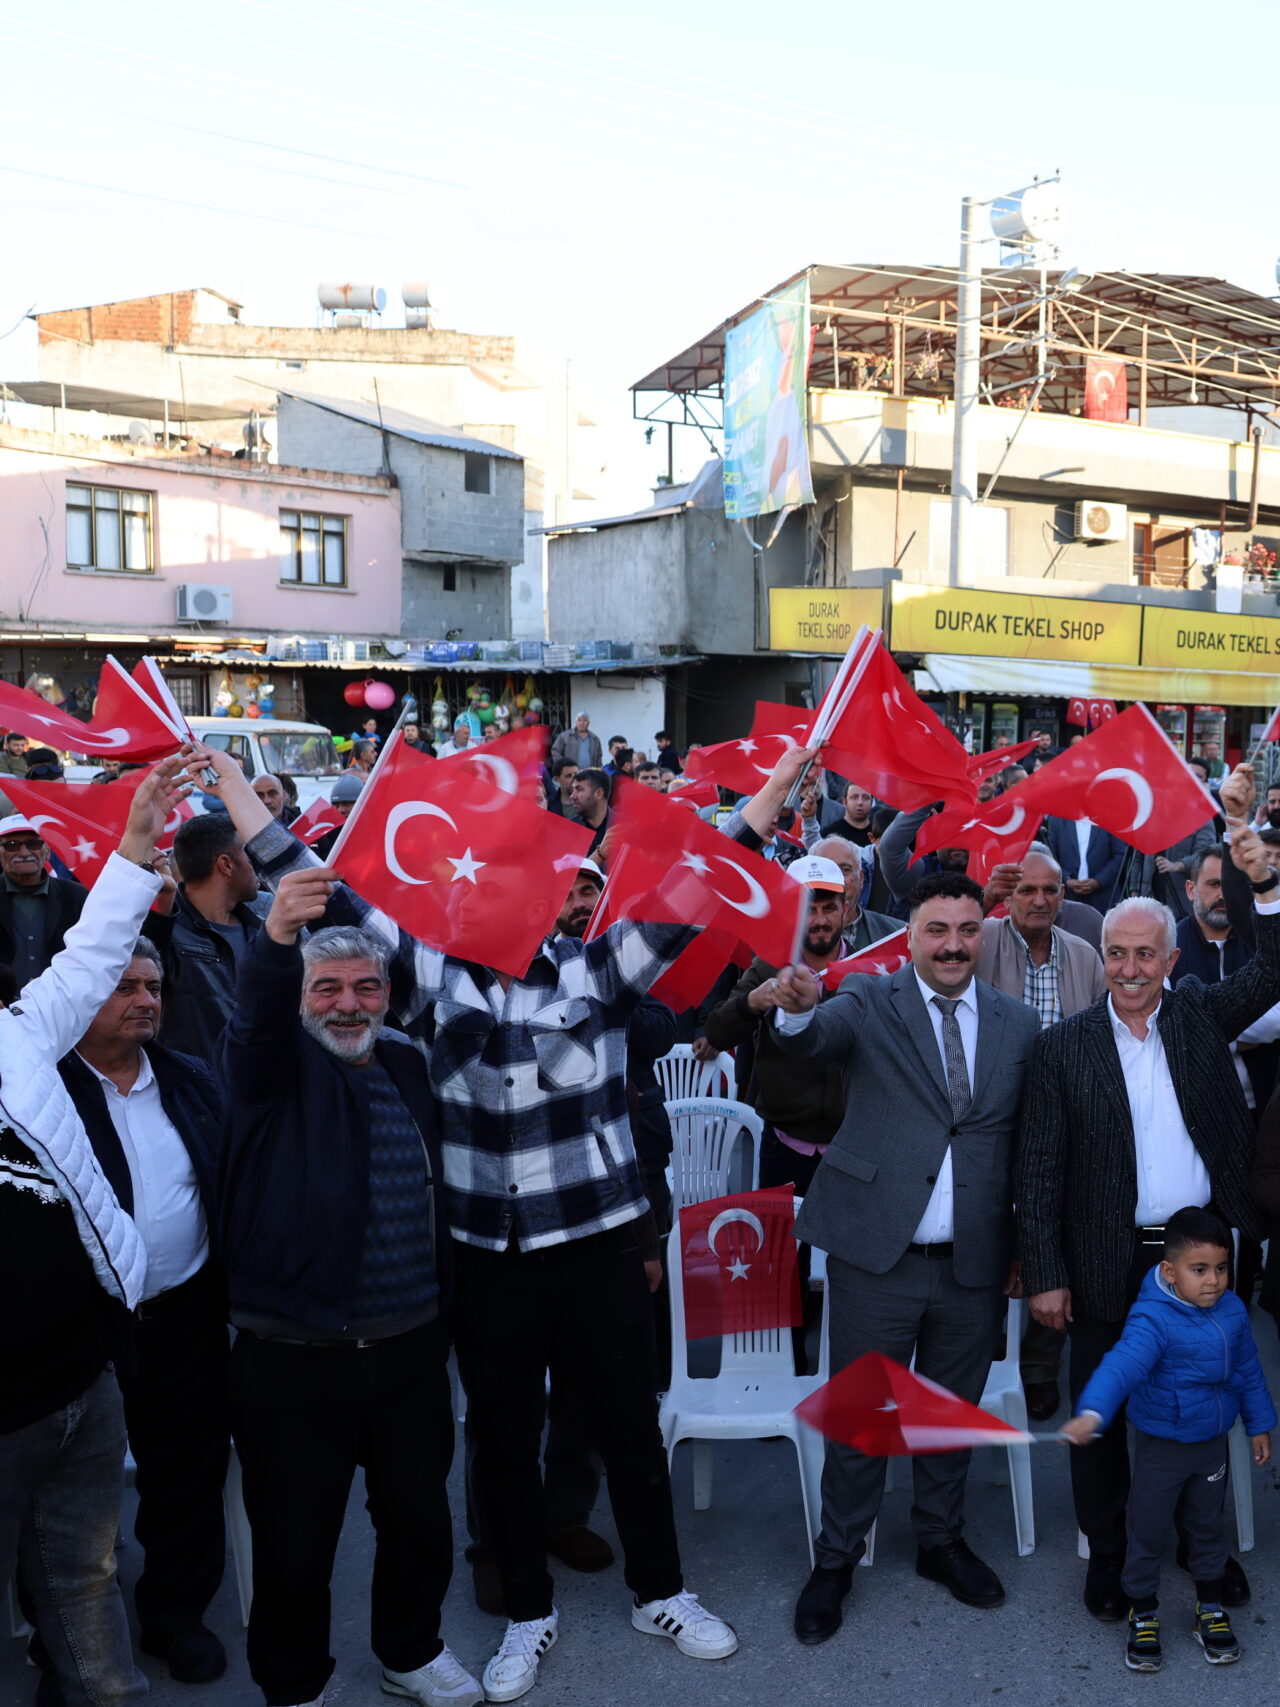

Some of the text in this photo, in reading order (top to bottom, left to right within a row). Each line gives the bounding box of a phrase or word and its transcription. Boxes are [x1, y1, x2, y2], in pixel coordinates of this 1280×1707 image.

[809, 602, 840, 618] DURAK
[798, 622, 851, 640] TEKEL SHOP
[935, 609, 1105, 641] DURAK TEKEL SHOP
[1176, 630, 1226, 650] DURAK
[1229, 634, 1271, 654] TEKEL
